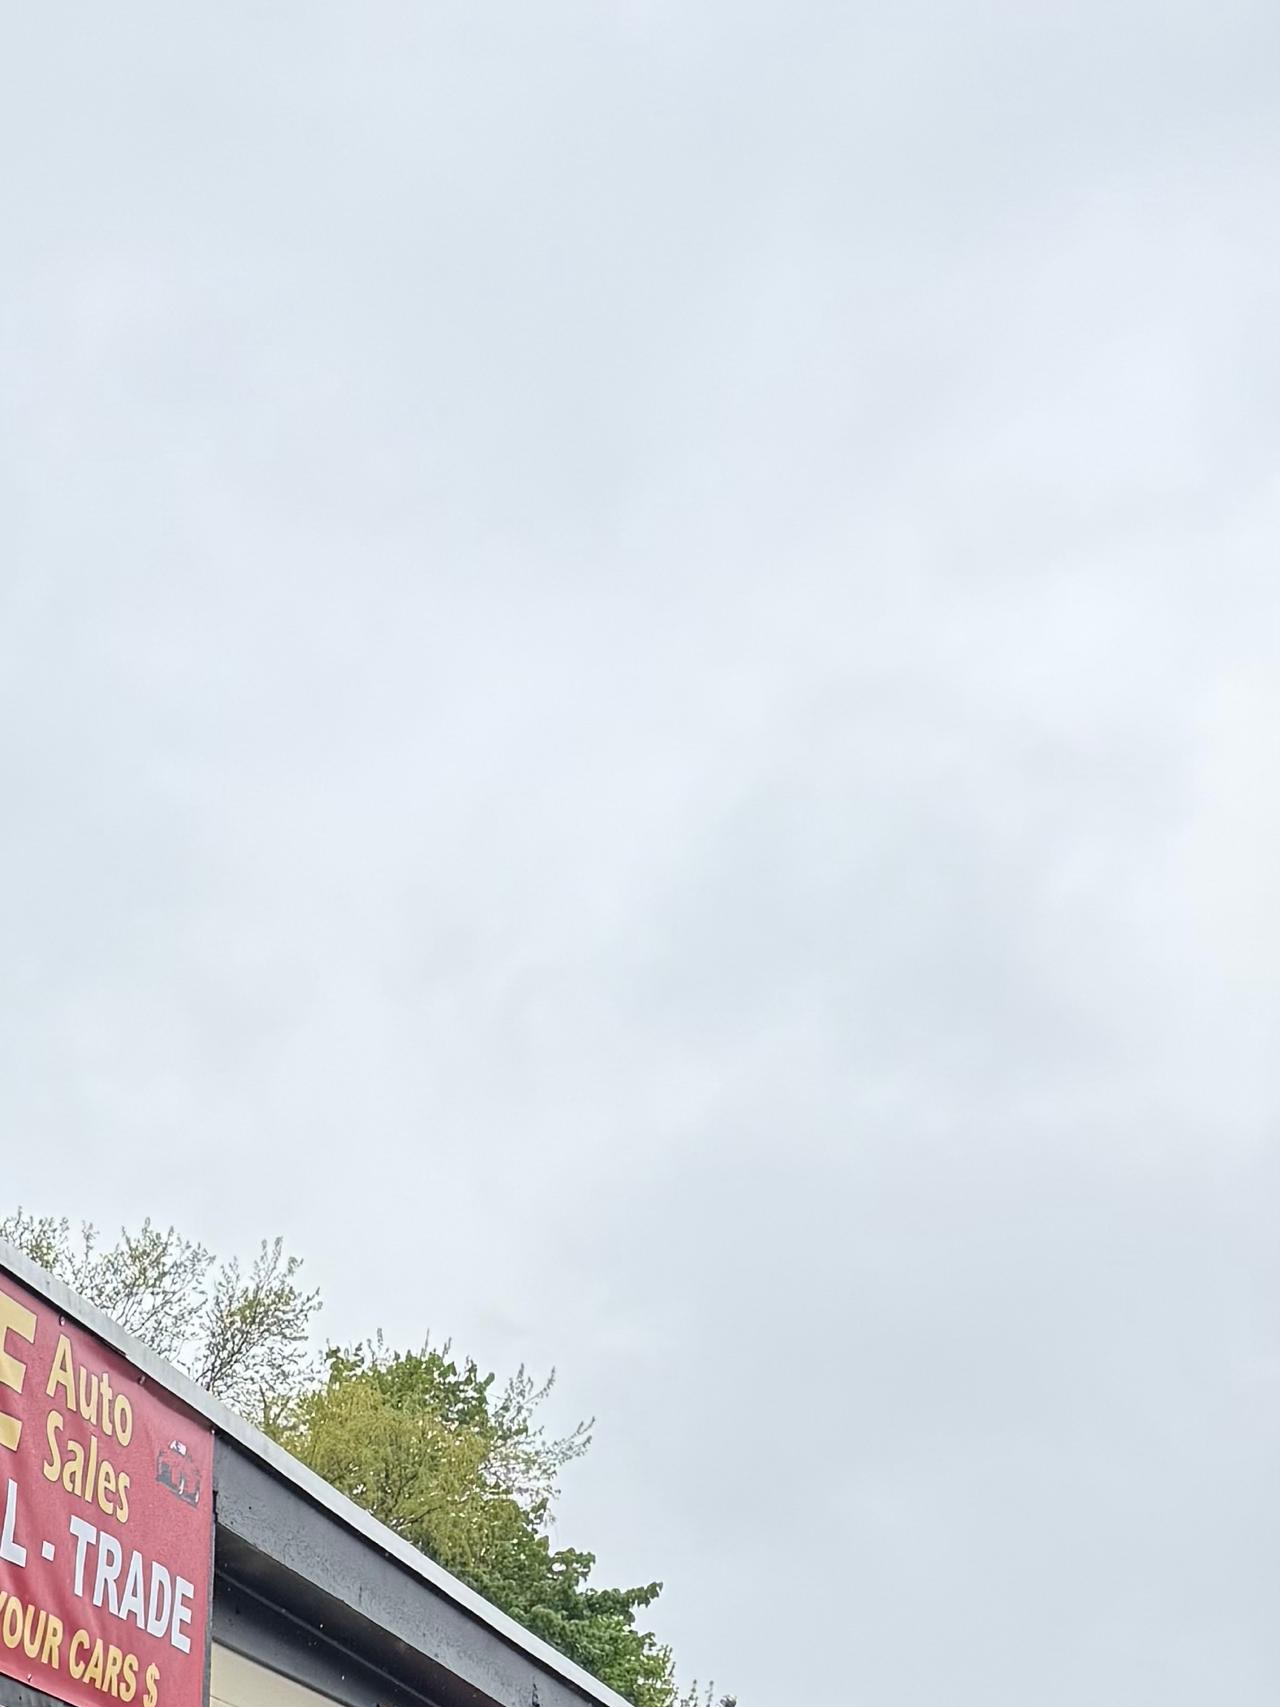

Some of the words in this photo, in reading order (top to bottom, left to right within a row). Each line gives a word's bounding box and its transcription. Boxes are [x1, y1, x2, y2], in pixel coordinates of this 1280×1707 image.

[46, 1334, 135, 1448] Auto
[42, 1410, 131, 1524] Sales
[69, 1515, 194, 1655] TRADE
[68, 1629, 138, 1702] CARS
